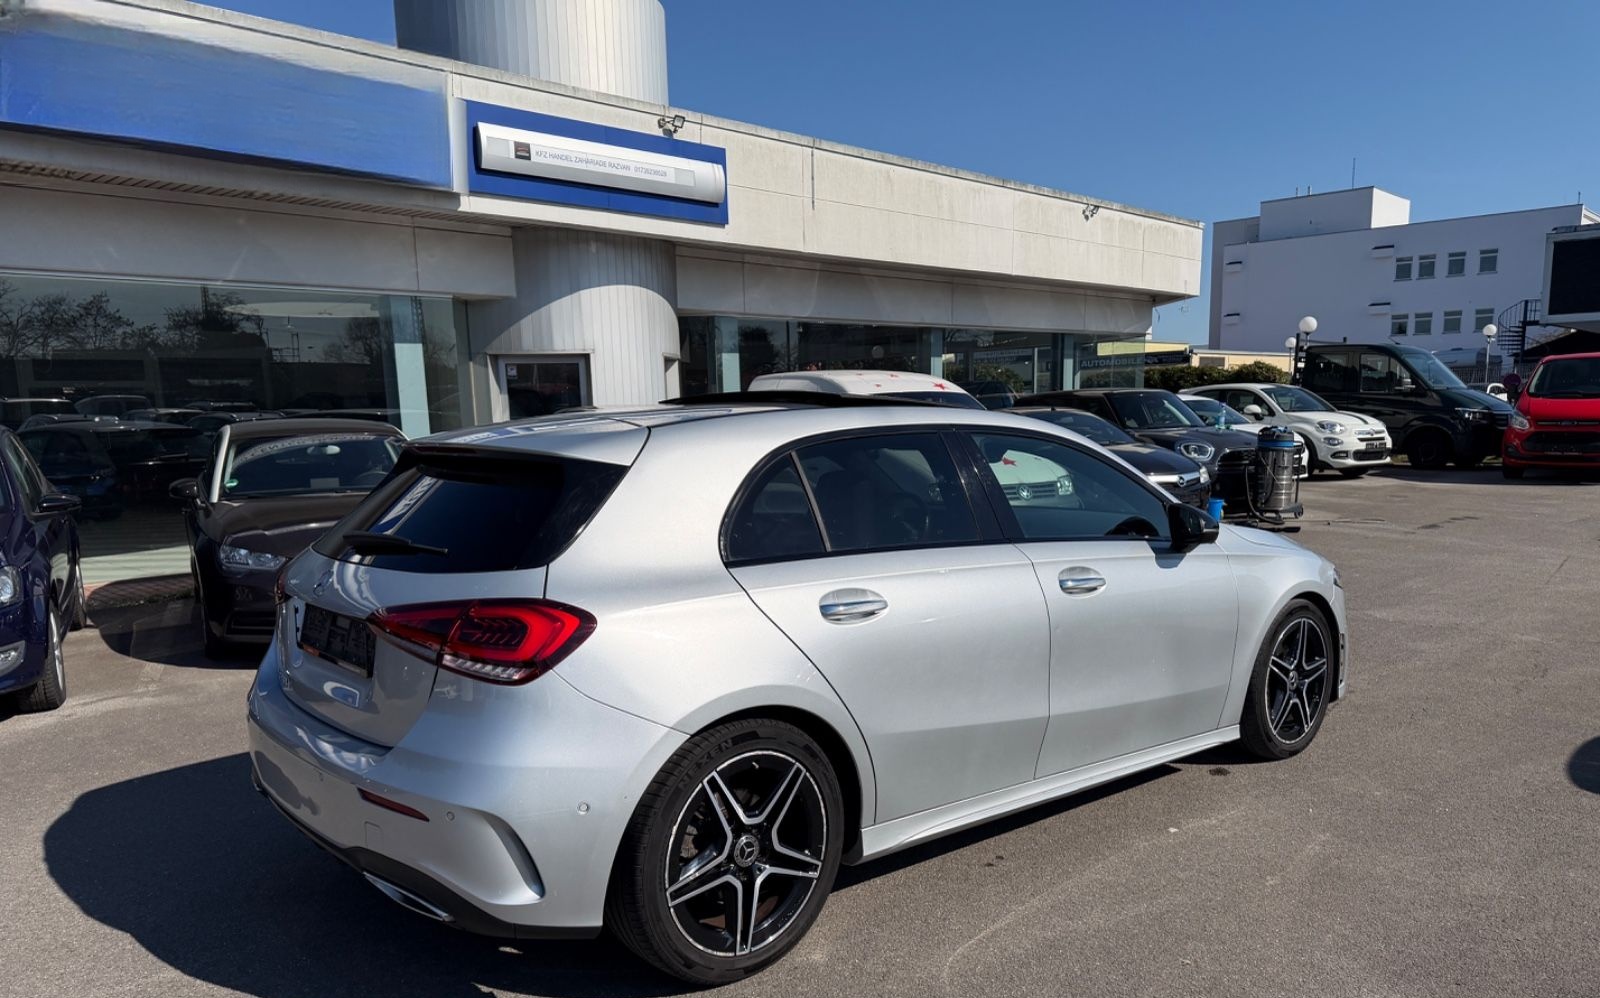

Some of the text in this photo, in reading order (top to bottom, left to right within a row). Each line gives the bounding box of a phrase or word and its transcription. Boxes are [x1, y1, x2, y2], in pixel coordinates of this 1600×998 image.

[535, 149, 548, 159] KFZ
[549, 152, 573, 162] HANDEL
[677, 738, 734, 790] NEXEN
